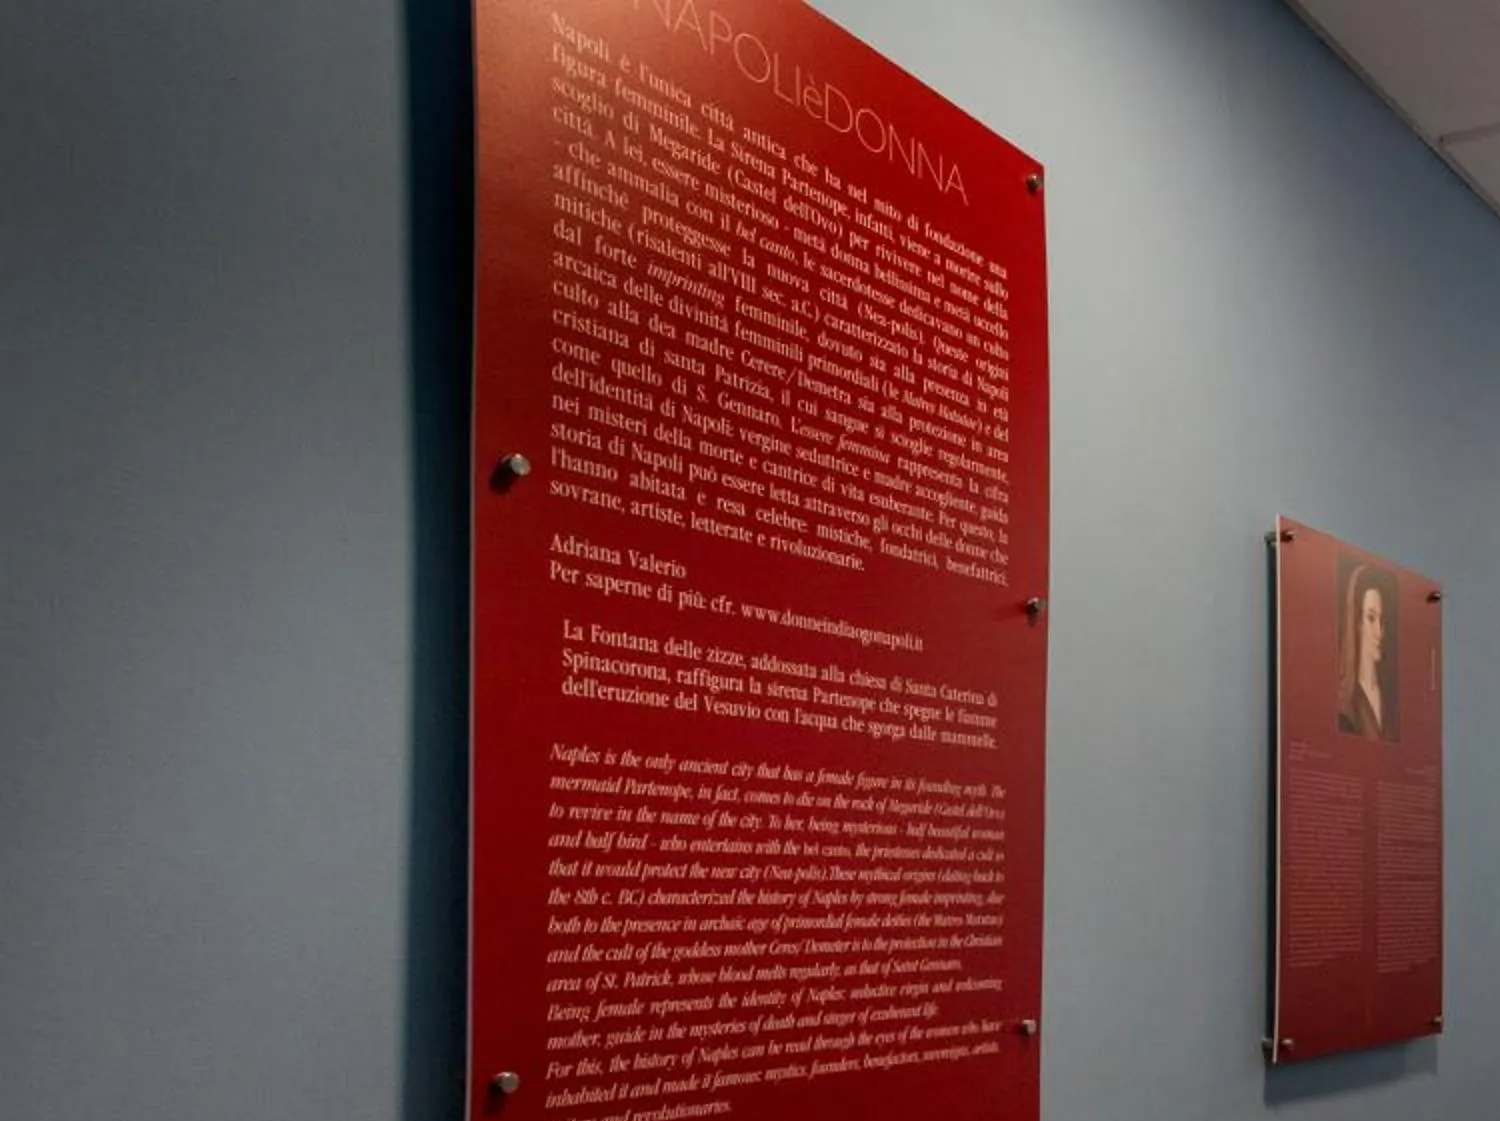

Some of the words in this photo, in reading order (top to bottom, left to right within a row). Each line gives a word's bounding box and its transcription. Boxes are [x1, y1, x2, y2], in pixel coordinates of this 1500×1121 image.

[551, 12, 609, 64] Napoli
[700, 101, 733, 132] città
[742, 124, 786, 160] antica
[793, 152, 817, 177] che
[824, 165, 841, 190] ha
[847, 182, 867, 204] nel
[552, 42, 606, 90] figura
[707, 126, 725, 152] La
[730, 138, 775, 179] Sirena
[551, 74, 614, 120] scoglio
[622, 106, 639, 133] di
[649, 121, 720, 174] Megaride
[726, 160, 776, 203] (Castel
[848, 228, 868, 250] per
[567, 141, 601, 171] che
[606, 160, 679, 208] ammalia
[685, 197, 713, 224] con
[720, 210, 730, 231] il
[552, 216, 581, 247] dal
[594, 234, 637, 270] forte
[553, 193, 621, 236] mitiche
[651, 154, 699, 191] essere
[704, 180, 779, 230] misterioso
[830, 239, 869, 274] donna
[642, 203, 731, 257] proteggesse
[742, 244, 755, 267] la
[766, 260, 809, 292] nuova
[818, 284, 848, 309] città
[552, 250, 617, 290] arcaica
[622, 273, 663, 308] delle
[668, 292, 728, 333] divinità
[734, 318, 803, 362] femminili
[552, 279, 599, 310] culto
[607, 299, 640, 326] alla
[648, 310, 675, 339] dea
[684, 329, 735, 361] madre
[551, 336, 599, 367] come
[610, 356, 662, 388] quello
[670, 373, 687, 396] di
[552, 307, 629, 349] cristiana
[638, 334, 655, 358] di
[664, 348, 705, 376] santa
[780, 386, 790, 406] il
[796, 396, 817, 416] cui
[551, 393, 580, 415] nei
[587, 404, 647, 436] misteri
[652, 419, 692, 449] della
[698, 438, 743, 465] morte
[762, 458, 816, 487] cantrice
[659, 395, 675, 418] di
[739, 426, 789, 455] vergine
[550, 421, 601, 450] storia
[607, 433, 625, 457] di
[631, 441, 683, 474] Napoli
[688, 461, 718, 484] può
[721, 471, 765, 496] essere
[769, 481, 799, 506] letta
[629, 469, 685, 500] abitata
[716, 495, 745, 516] resa
[550, 531, 621, 565] Adriana
[628, 549, 686, 579] Valerio
[690, 511, 753, 544] letterate
[549, 559, 579, 584] Per
[585, 571, 651, 598] saperne
[656, 581, 672, 602] di
[562, 646, 669, 684] Spinacorona,
[676, 666, 743, 693] raffigura
[748, 675, 761, 694] la
[767, 679, 808, 701] sirena
[563, 618, 583, 640] La
[590, 623, 658, 652] Fontana
[663, 635, 702, 660] delle
[706, 644, 746, 670] zizze,
[750, 652, 817, 678] addossata
[821, 664, 845, 683] alla
[673, 690, 698, 711] del
[703, 695, 761, 719] Vesuvio
[764, 707, 790, 723] con
[550, 740, 602, 767] Naples
[604, 745, 618, 764] is
[620, 747, 642, 766] the
[548, 827, 584, 847] and
[546, 1059, 572, 1079] For
